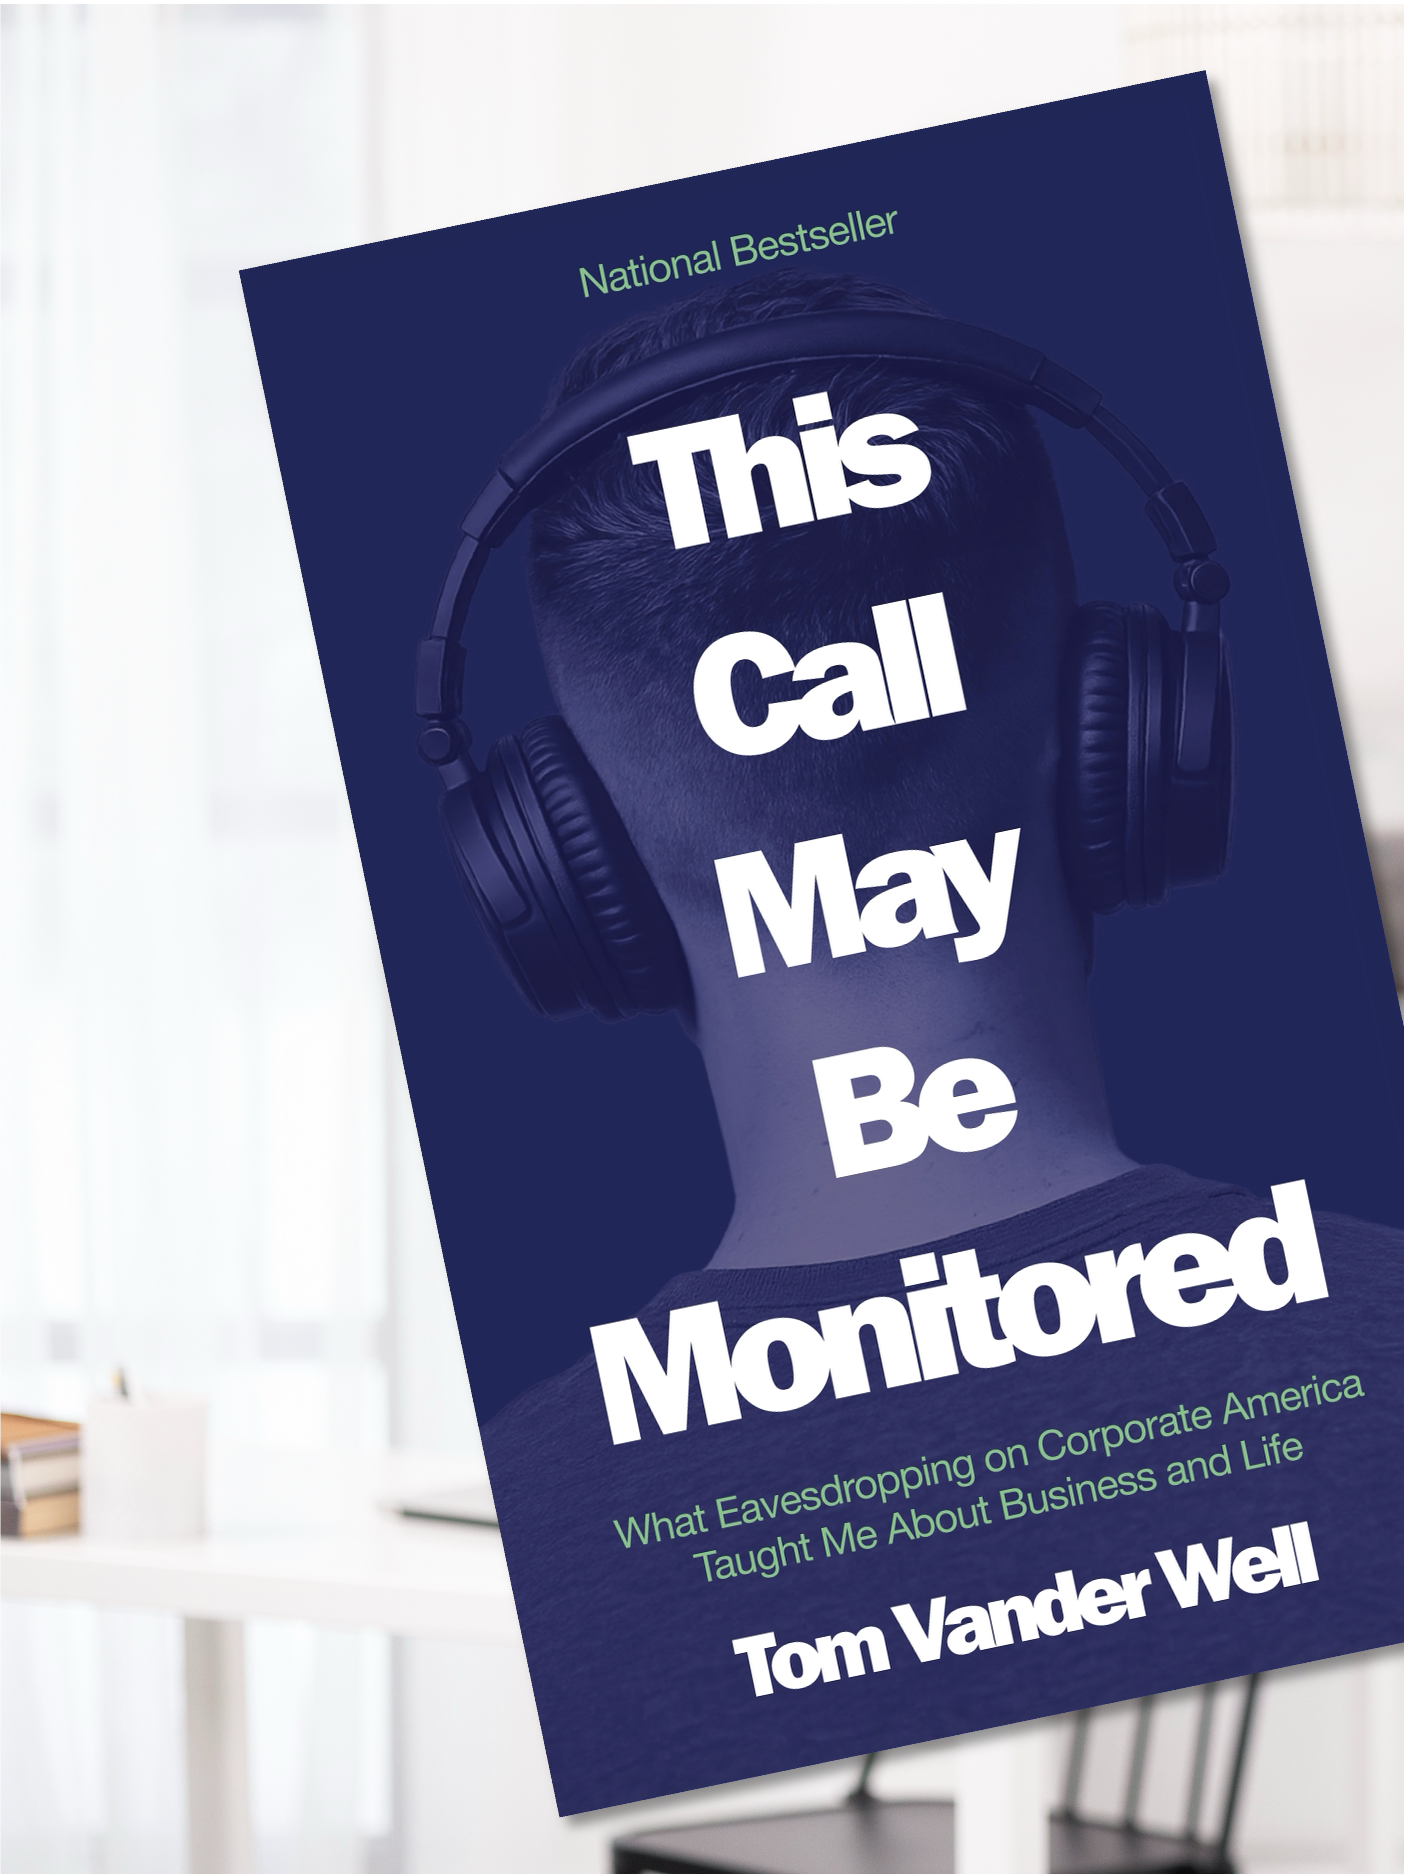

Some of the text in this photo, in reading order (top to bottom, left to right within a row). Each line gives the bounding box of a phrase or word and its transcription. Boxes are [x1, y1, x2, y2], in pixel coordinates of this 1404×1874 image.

[579, 210, 898, 298] National Bestseller
[626, 391, 932, 550] This
[692, 591, 968, 757] Call
[713, 827, 1022, 979] May
[811, 1045, 1019, 1179] Be
[589, 1178, 1330, 1446] Monitored
[612, 1374, 1366, 1549] What Eavesdropping on Corporate America
[692, 1432, 1304, 1582] Taught Me About Business and Life
[731, 1520, 1320, 1698] Tom Vander Well
